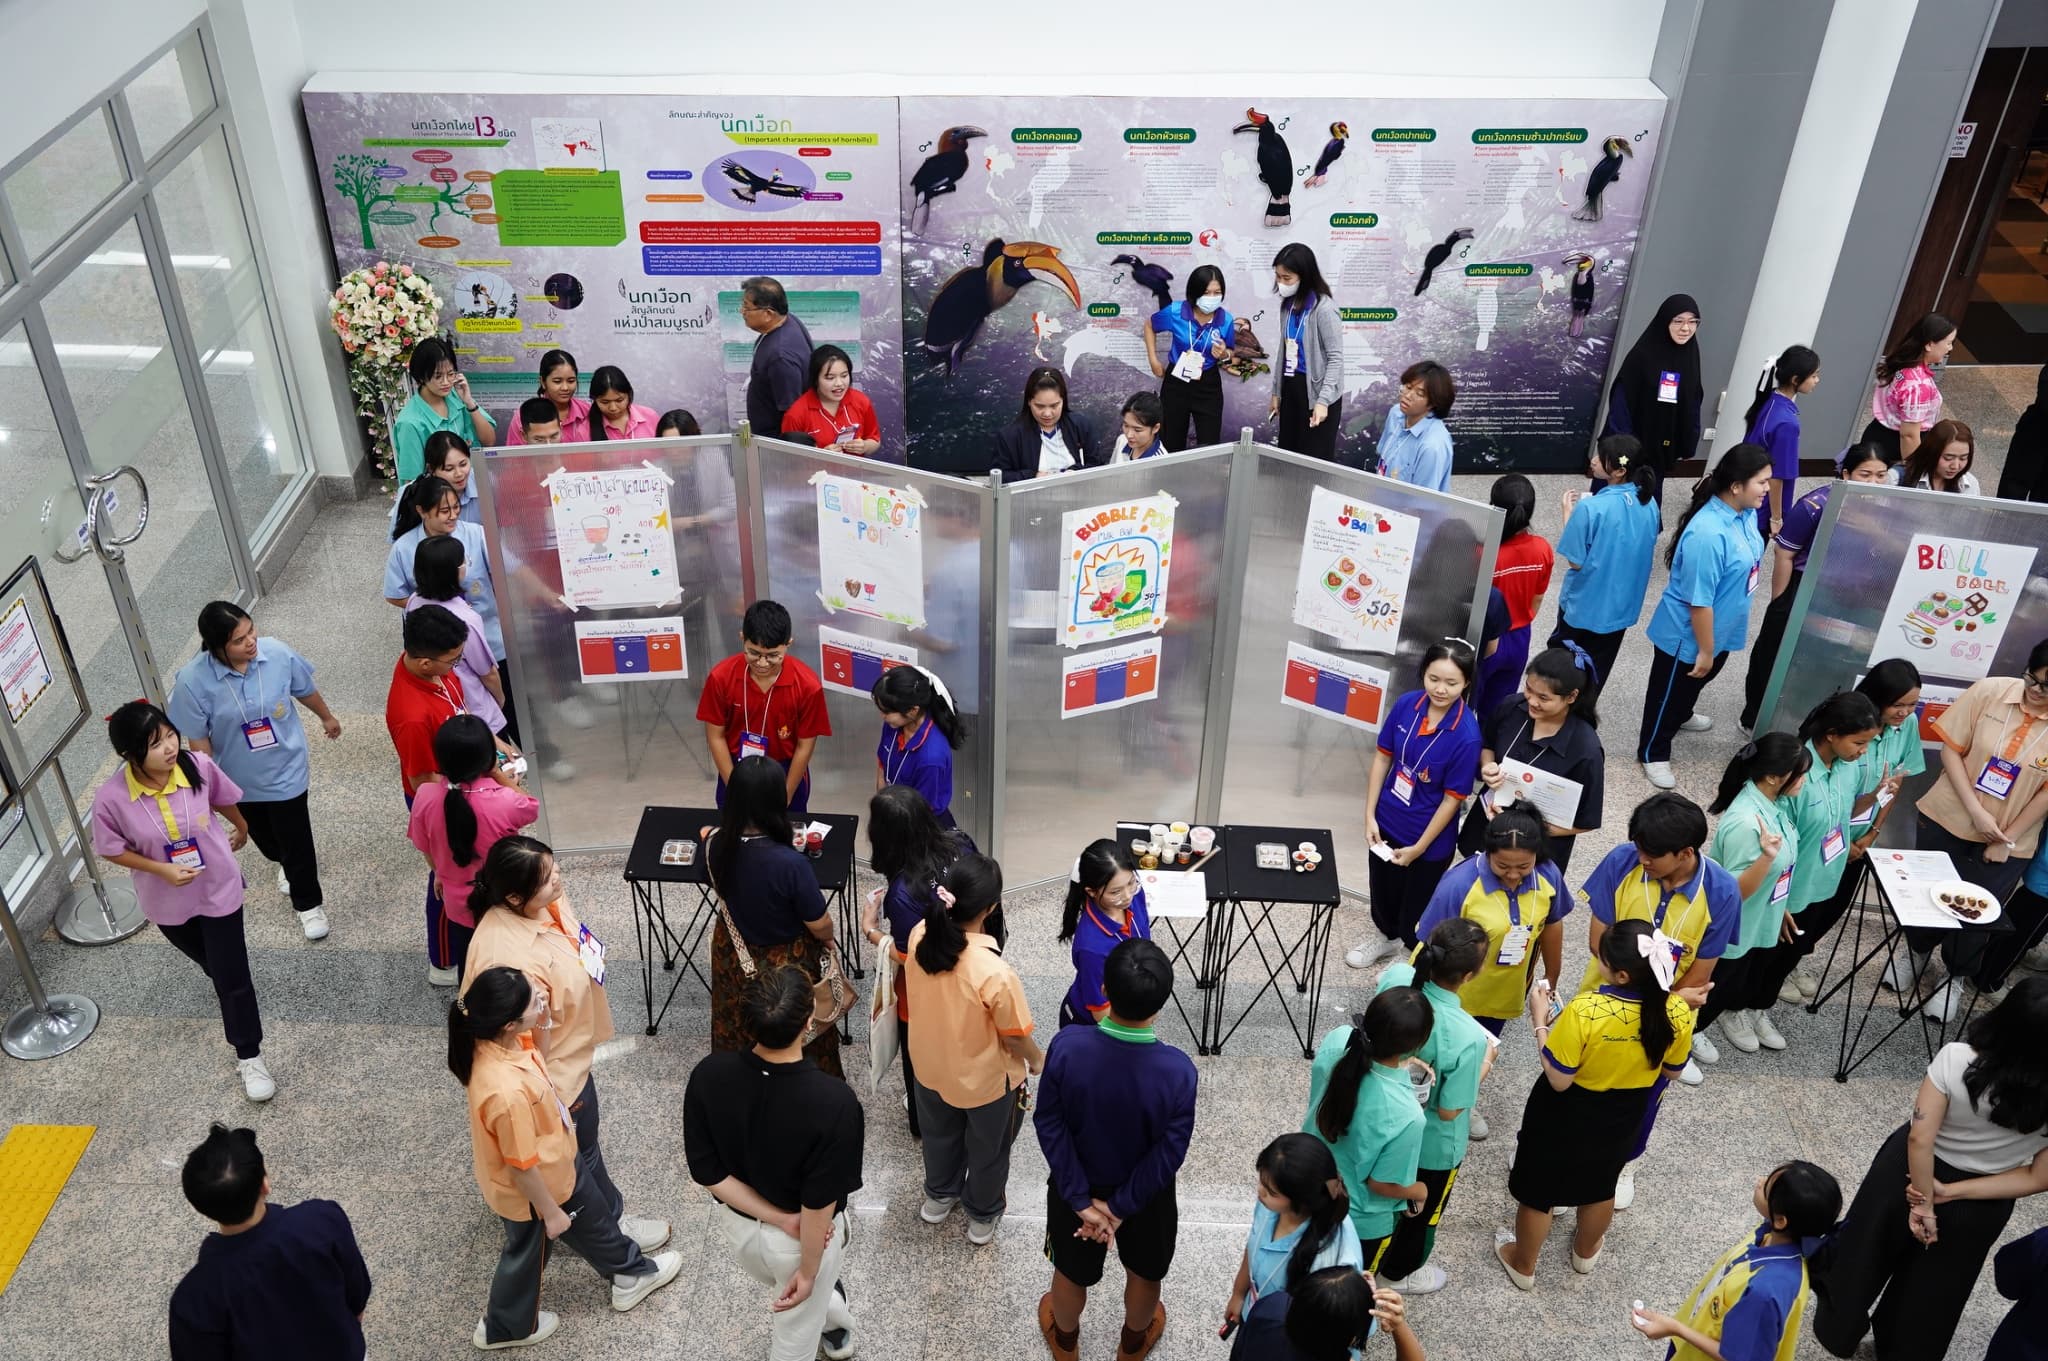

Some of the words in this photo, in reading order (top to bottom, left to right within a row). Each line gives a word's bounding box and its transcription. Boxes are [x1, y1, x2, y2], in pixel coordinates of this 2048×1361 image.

[411, 119, 475, 130] นกเงือกไทย
[474, 116, 496, 137] 13
[721, 114, 792, 133] นกเงือก
[744, 136, 781, 144] (Important
[1015, 131, 1078, 141] นกเงือกคอแดง
[1130, 131, 1190, 140] นกเงือกหัวแรด
[1333, 215, 1376, 225] นกเงือกดำ
[629, 287, 691, 304] นกเงือก
[613, 315, 704, 331] แห่งป่าสมบูรณ์
[1075, 506, 1139, 542] BUBBLE
[1917, 543, 1990, 577] BALL
